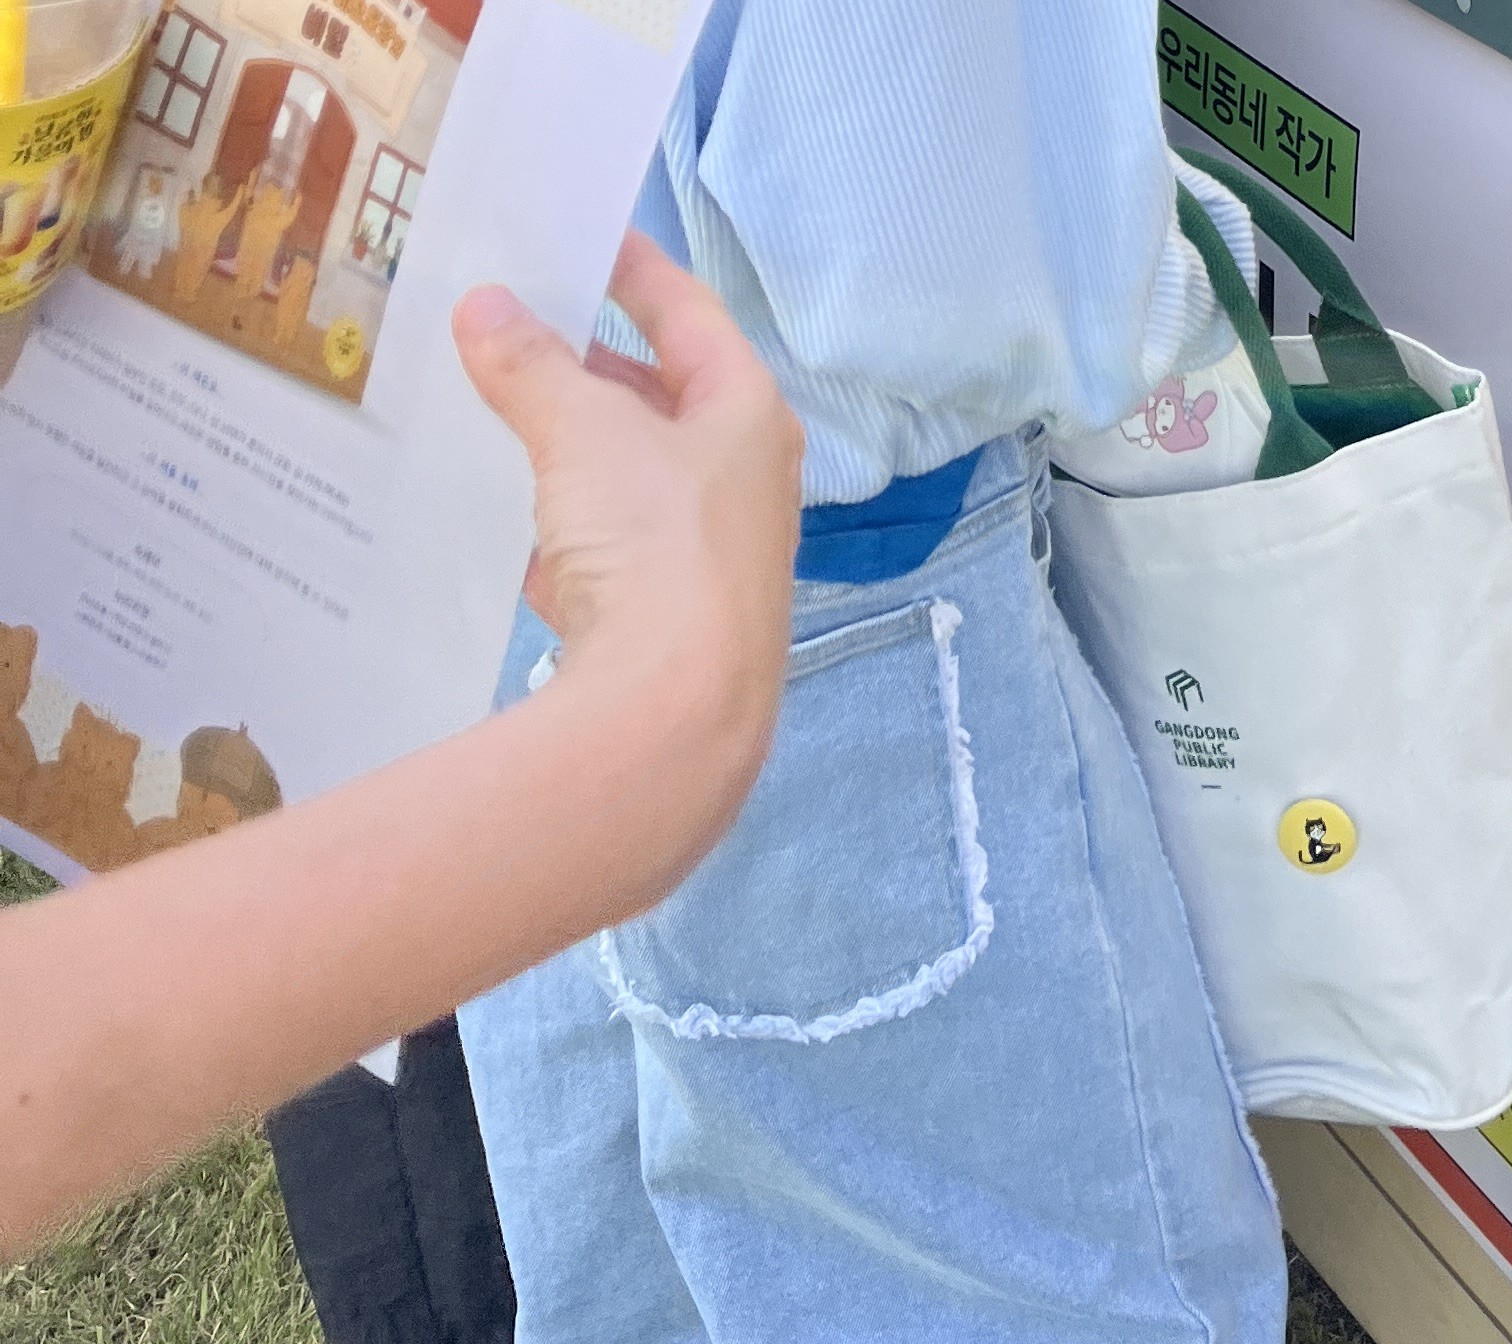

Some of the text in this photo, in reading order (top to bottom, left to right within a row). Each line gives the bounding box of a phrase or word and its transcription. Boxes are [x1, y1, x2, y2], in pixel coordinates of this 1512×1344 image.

[1157, 26, 1338, 199] 우리동네 작가
[1154, 719, 1241, 741] GANGDONG
[1173, 738, 1228, 757] PUBLIC
[1174, 752, 1236, 770] LIBRARY
